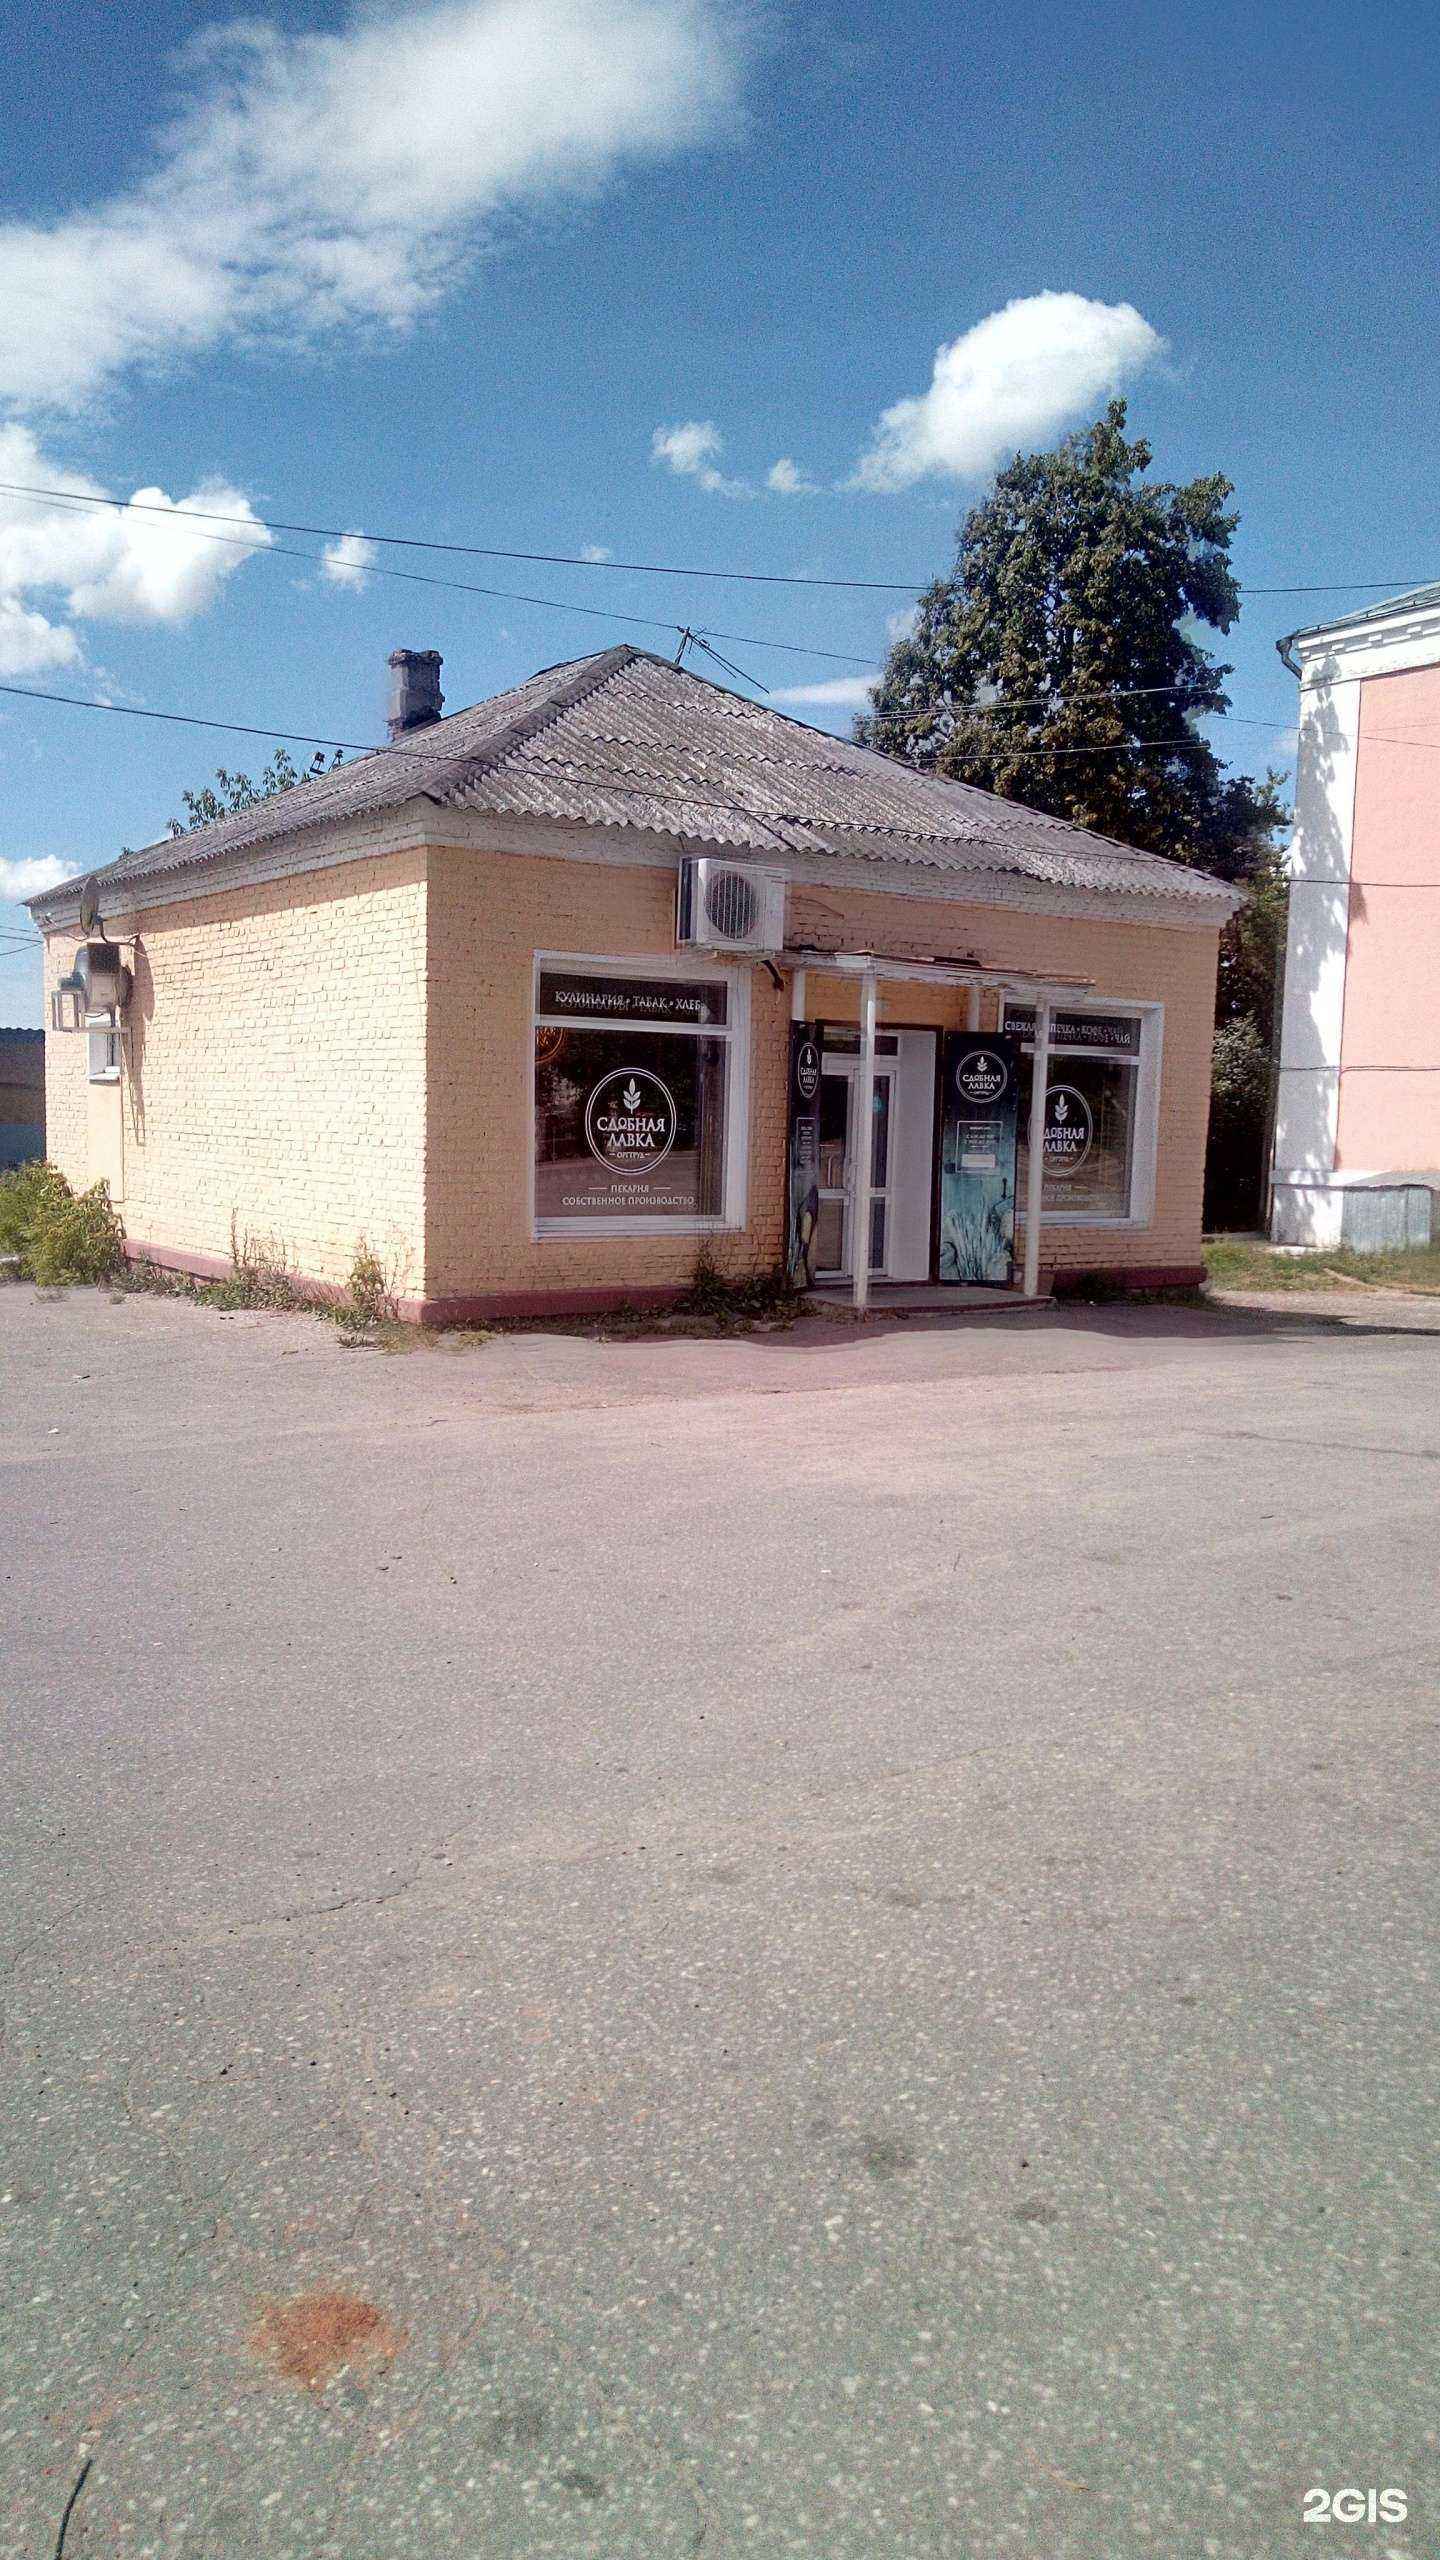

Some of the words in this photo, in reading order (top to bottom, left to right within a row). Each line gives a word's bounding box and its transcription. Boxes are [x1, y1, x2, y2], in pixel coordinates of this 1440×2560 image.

[555, 991, 624, 1006] КУЛИНАРИЯ
[632, 995, 668, 1008] ТАБАК
[675, 998, 701, 1010] ХЛЕБ
[962, 1074, 1001, 1082] СДОБНАЯ
[967, 1082, 996, 1090] ЛАВКА
[596, 1117, 666, 1132] СДОБНАЯ
[1043, 1127, 1085, 1140] ДОБНАЯ
[607, 1133, 656, 1147] ЛАВКА
[1043, 1140, 1077, 1152] ЛАВКА
[611, 1184, 650, 1193] ПЕКАРНЯ
[562, 1196, 626, 1206] СОБСТВЕННОЕ
